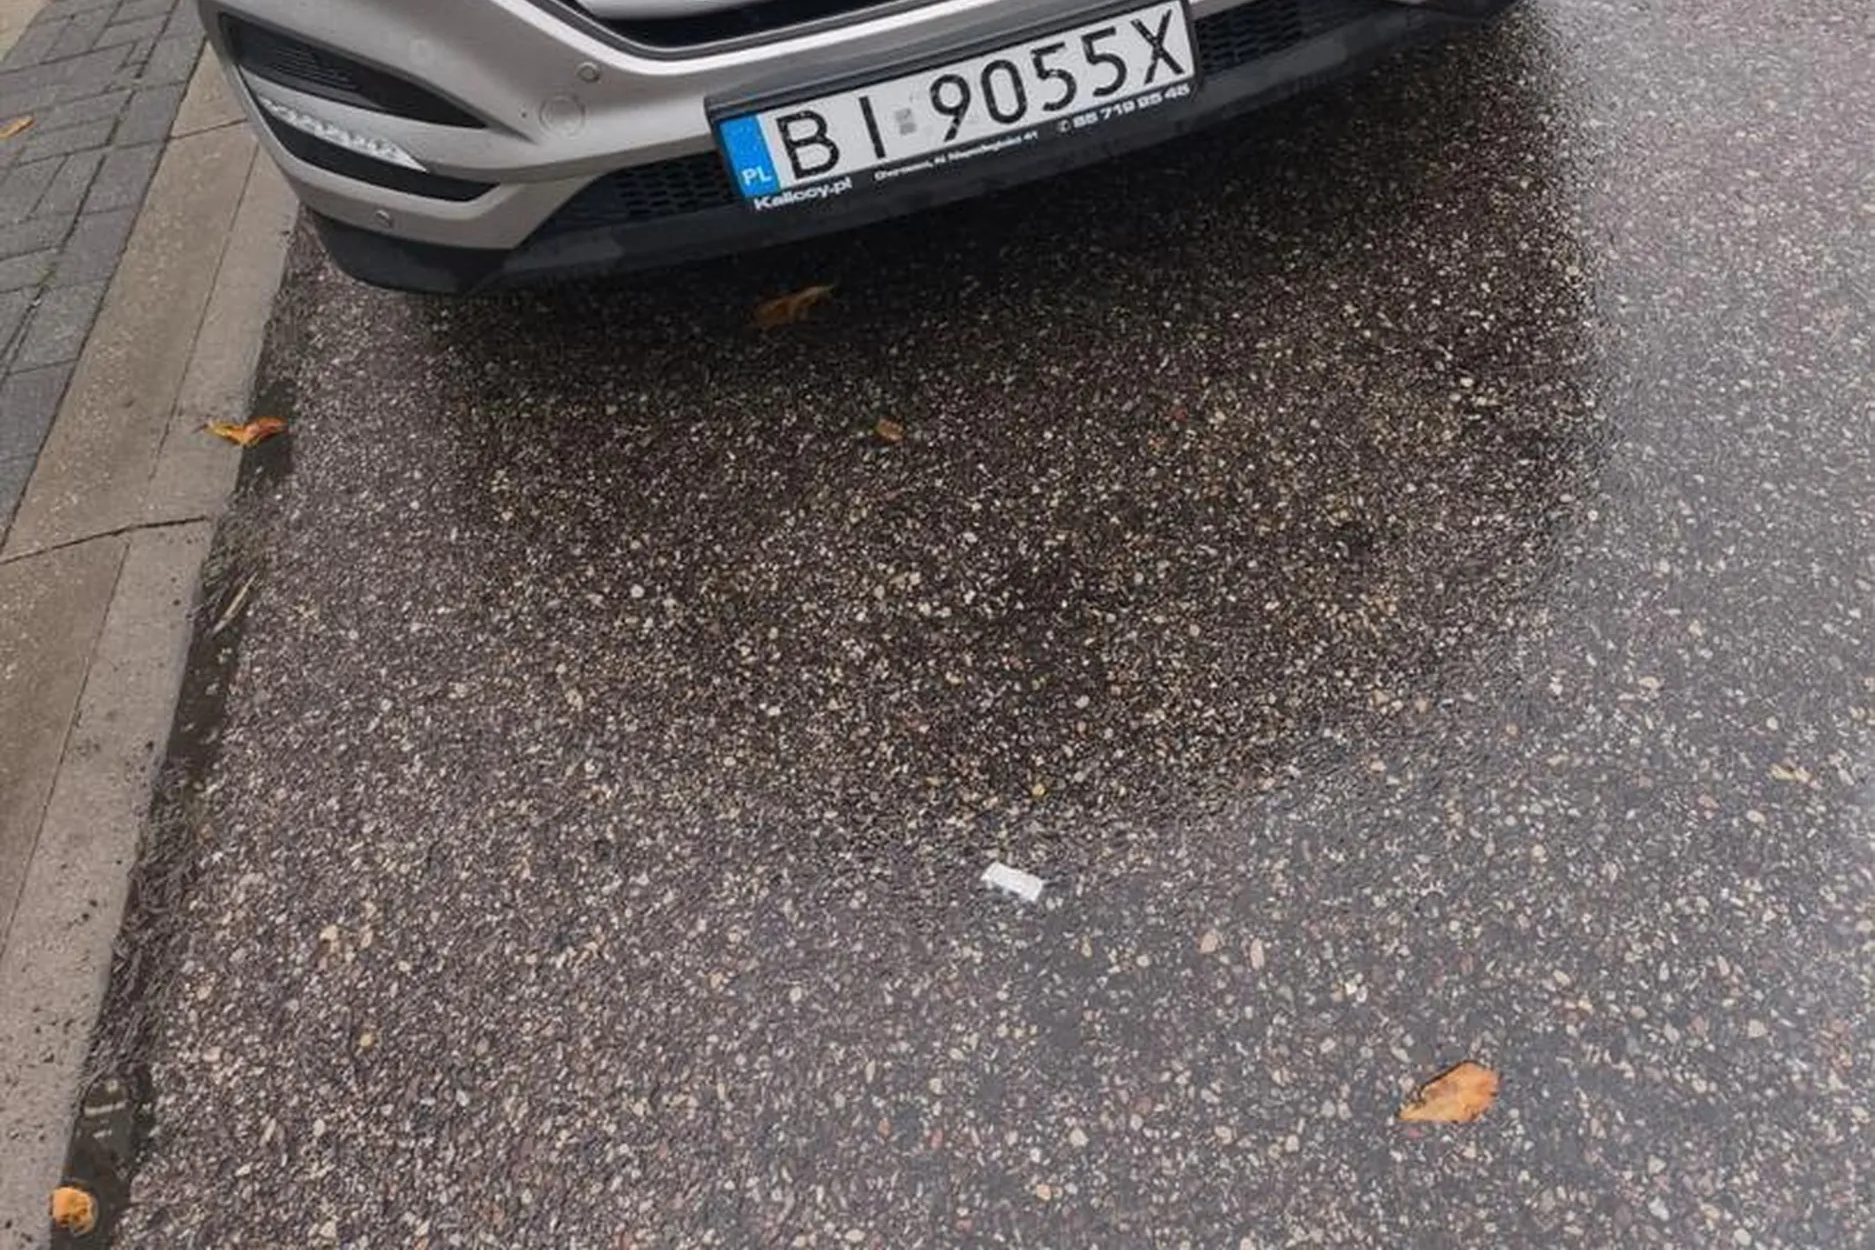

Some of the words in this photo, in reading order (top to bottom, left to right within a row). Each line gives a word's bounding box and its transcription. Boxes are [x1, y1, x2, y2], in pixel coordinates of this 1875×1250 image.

[776, 96, 887, 179] BI
[929, 9, 1186, 142] 9055X
[742, 166, 772, 186] PL
